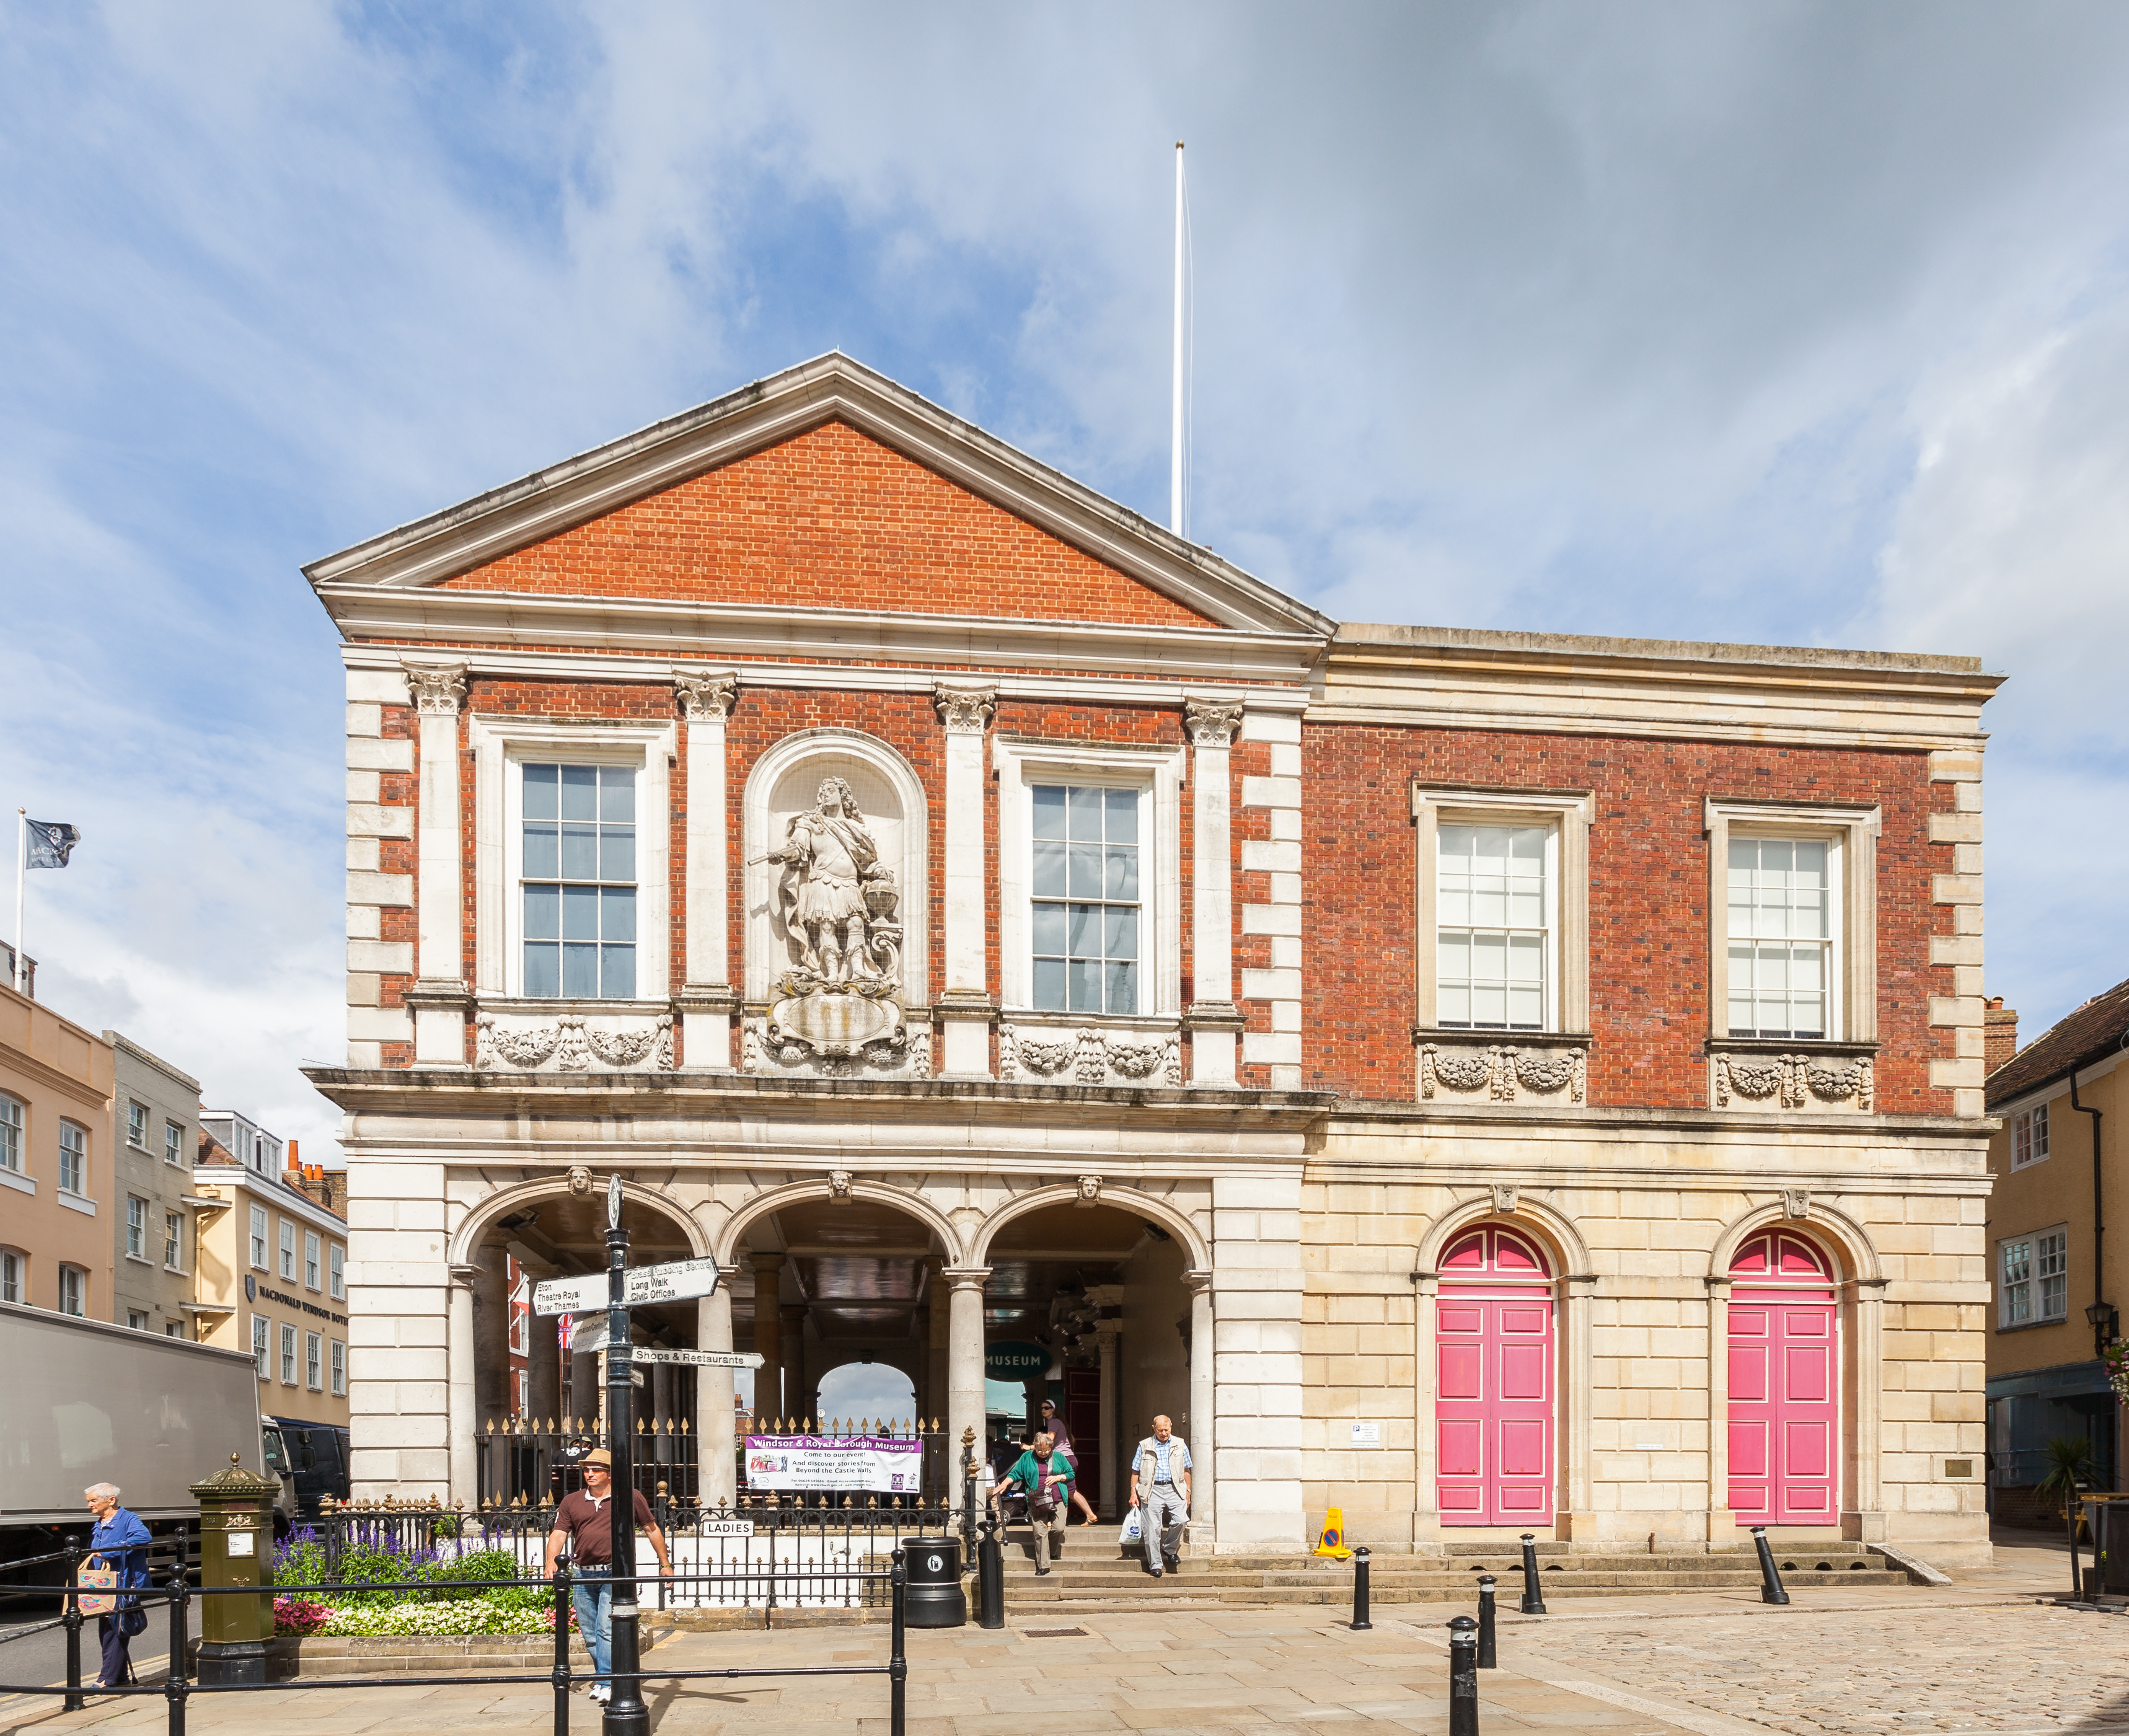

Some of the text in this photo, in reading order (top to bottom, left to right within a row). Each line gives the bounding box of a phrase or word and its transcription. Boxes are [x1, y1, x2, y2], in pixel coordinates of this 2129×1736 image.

[685, 1261, 711, 1271] Centre
[538, 1284, 552, 1292] Eton
[631, 1277, 668, 1291] Long Walk
[538, 1290, 581, 1302] Theatre Royal
[631, 1289, 676, 1301] Civic Offices
[259, 1285, 301, 1309] MACDONALD
[302, 1301, 331, 1320] WINDSOR
[537, 1302, 580, 1313] River Thames
[637, 1351, 744, 1364] Shops & Restaurants
[985, 1355, 1041, 1365] MUSEUM
[754, 1439, 914, 1451] Windsor & Royal Borough Museum
[708, 1523, 749, 1533] LADIES
